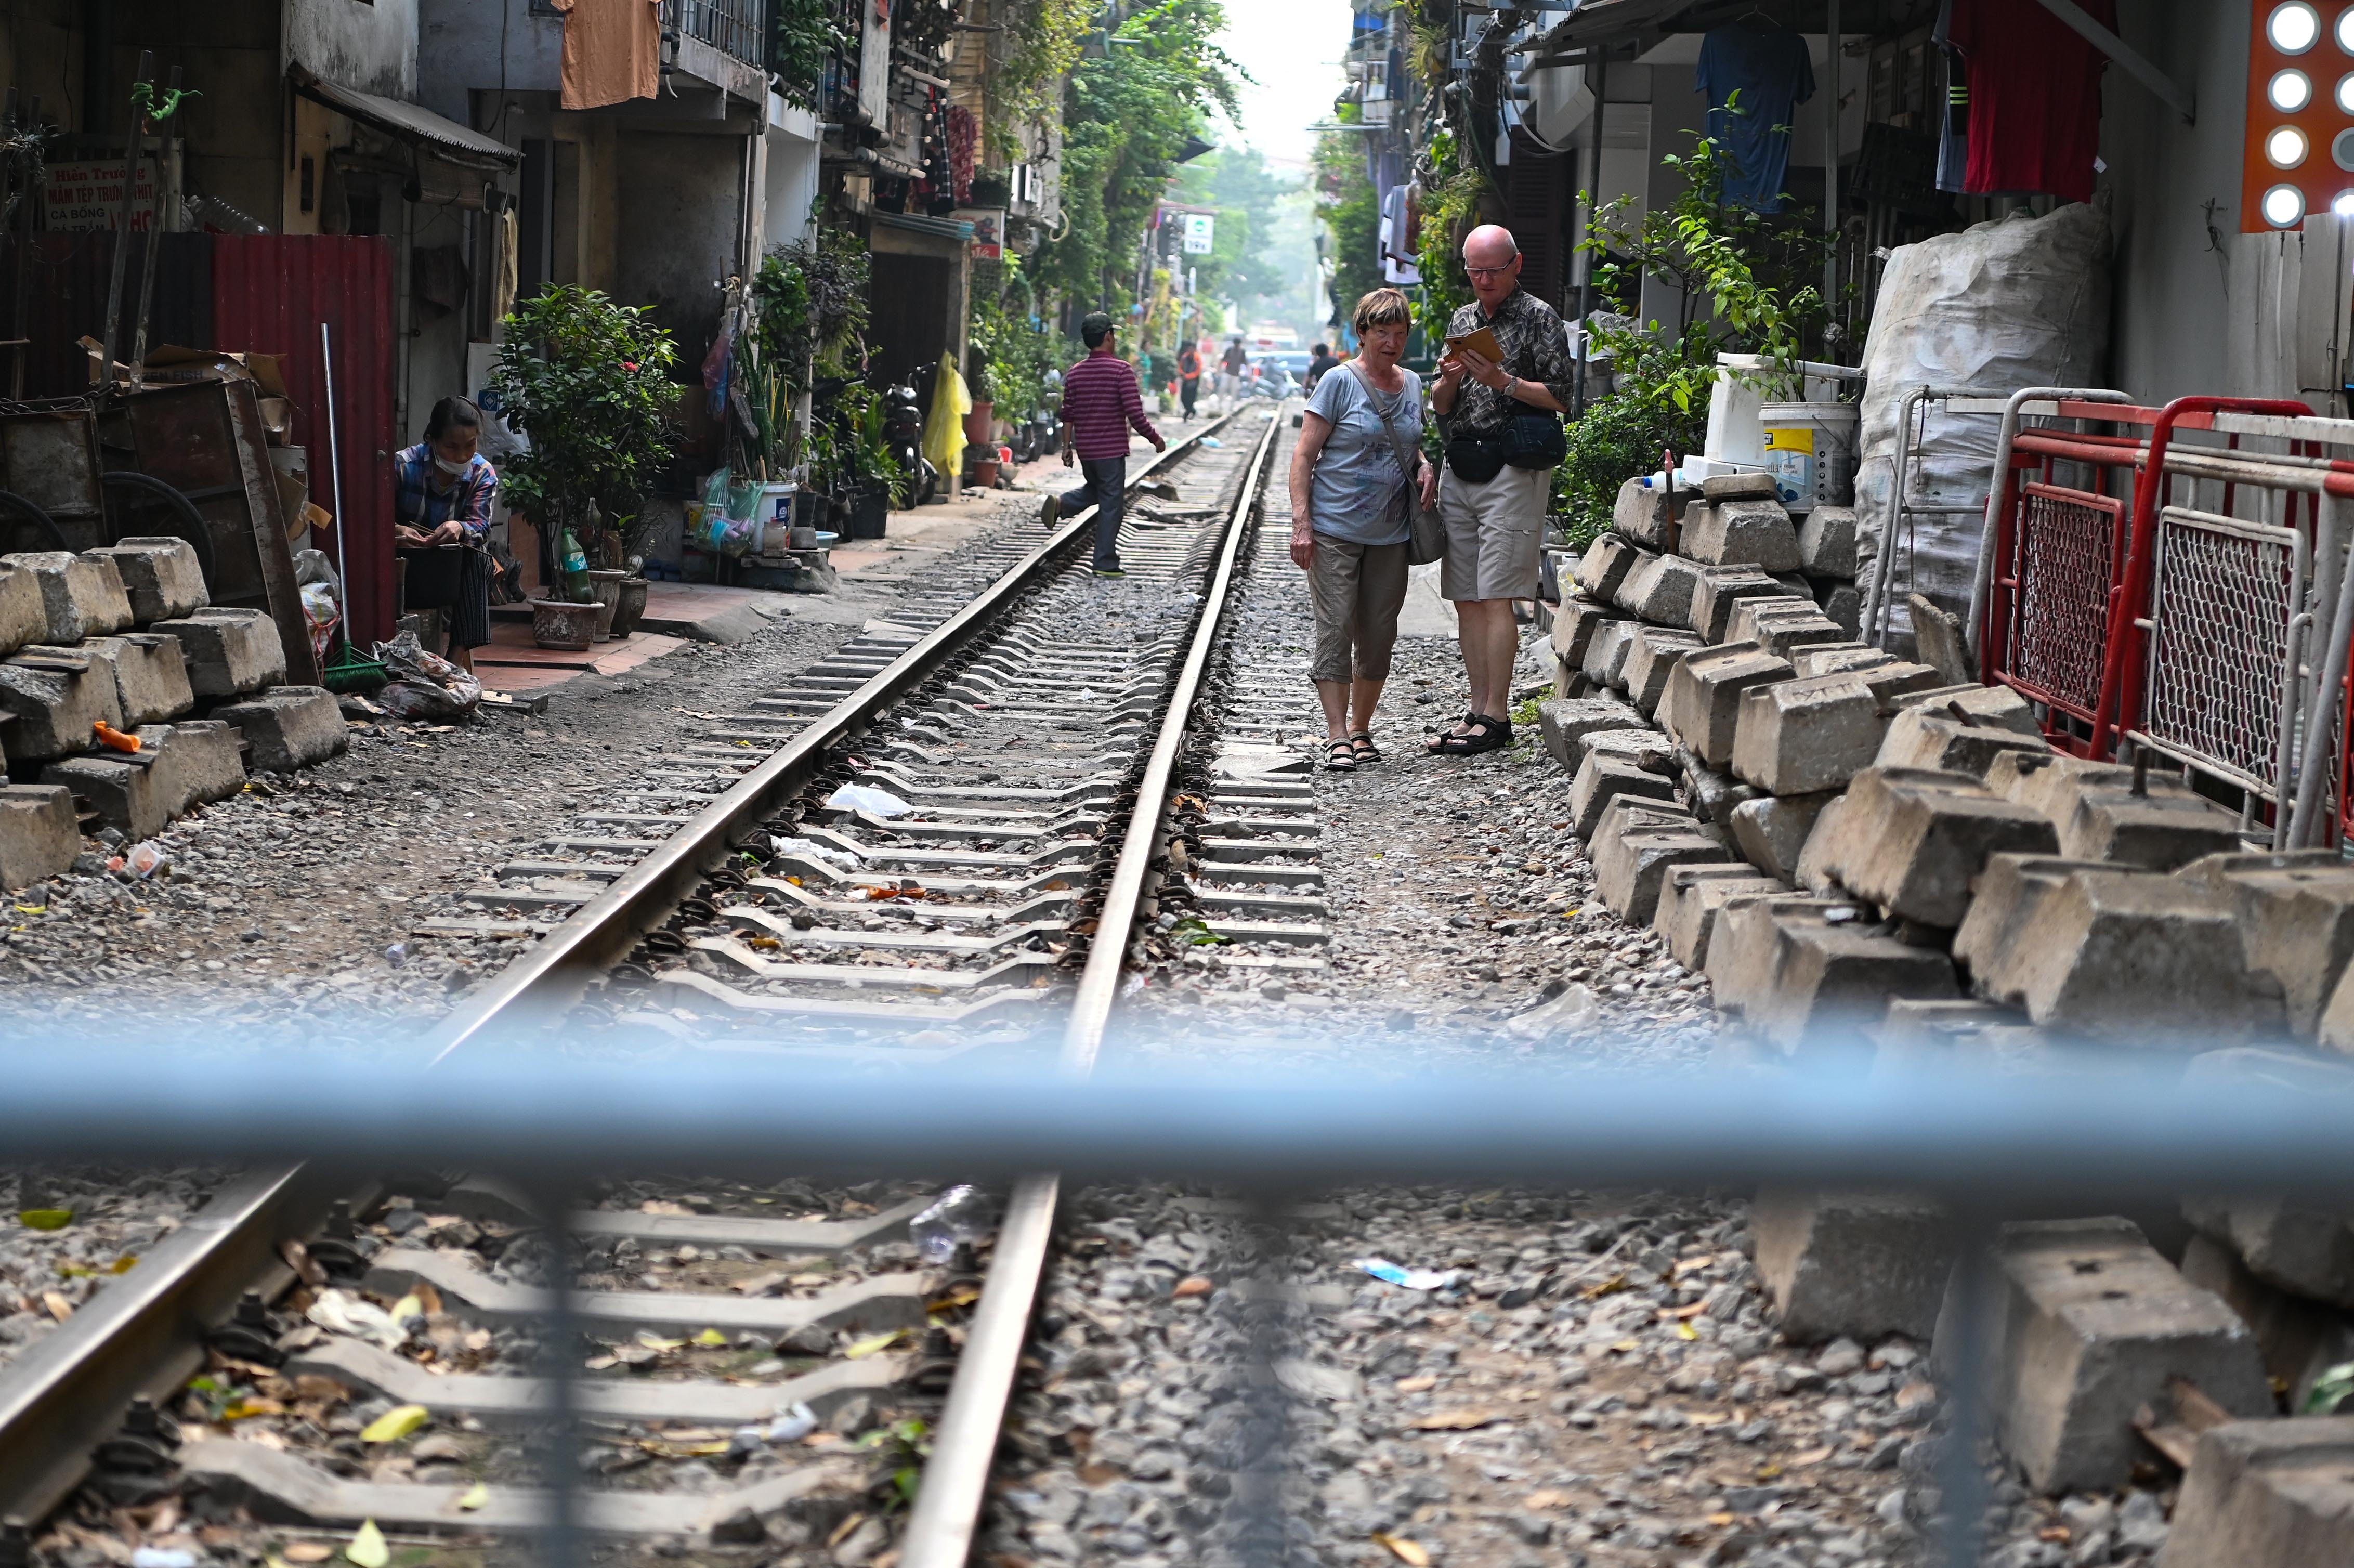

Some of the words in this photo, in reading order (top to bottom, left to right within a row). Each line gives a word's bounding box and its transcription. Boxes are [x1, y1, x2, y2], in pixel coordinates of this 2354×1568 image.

[92, 165, 145, 180] Trườg
[76, 185, 94, 203] TÉP
[97, 184, 123, 202] TRƯN
[51, 207, 67, 220] CÁ
[71, 205, 105, 219] BỐNG
[175, 370, 203, 381] FISH
